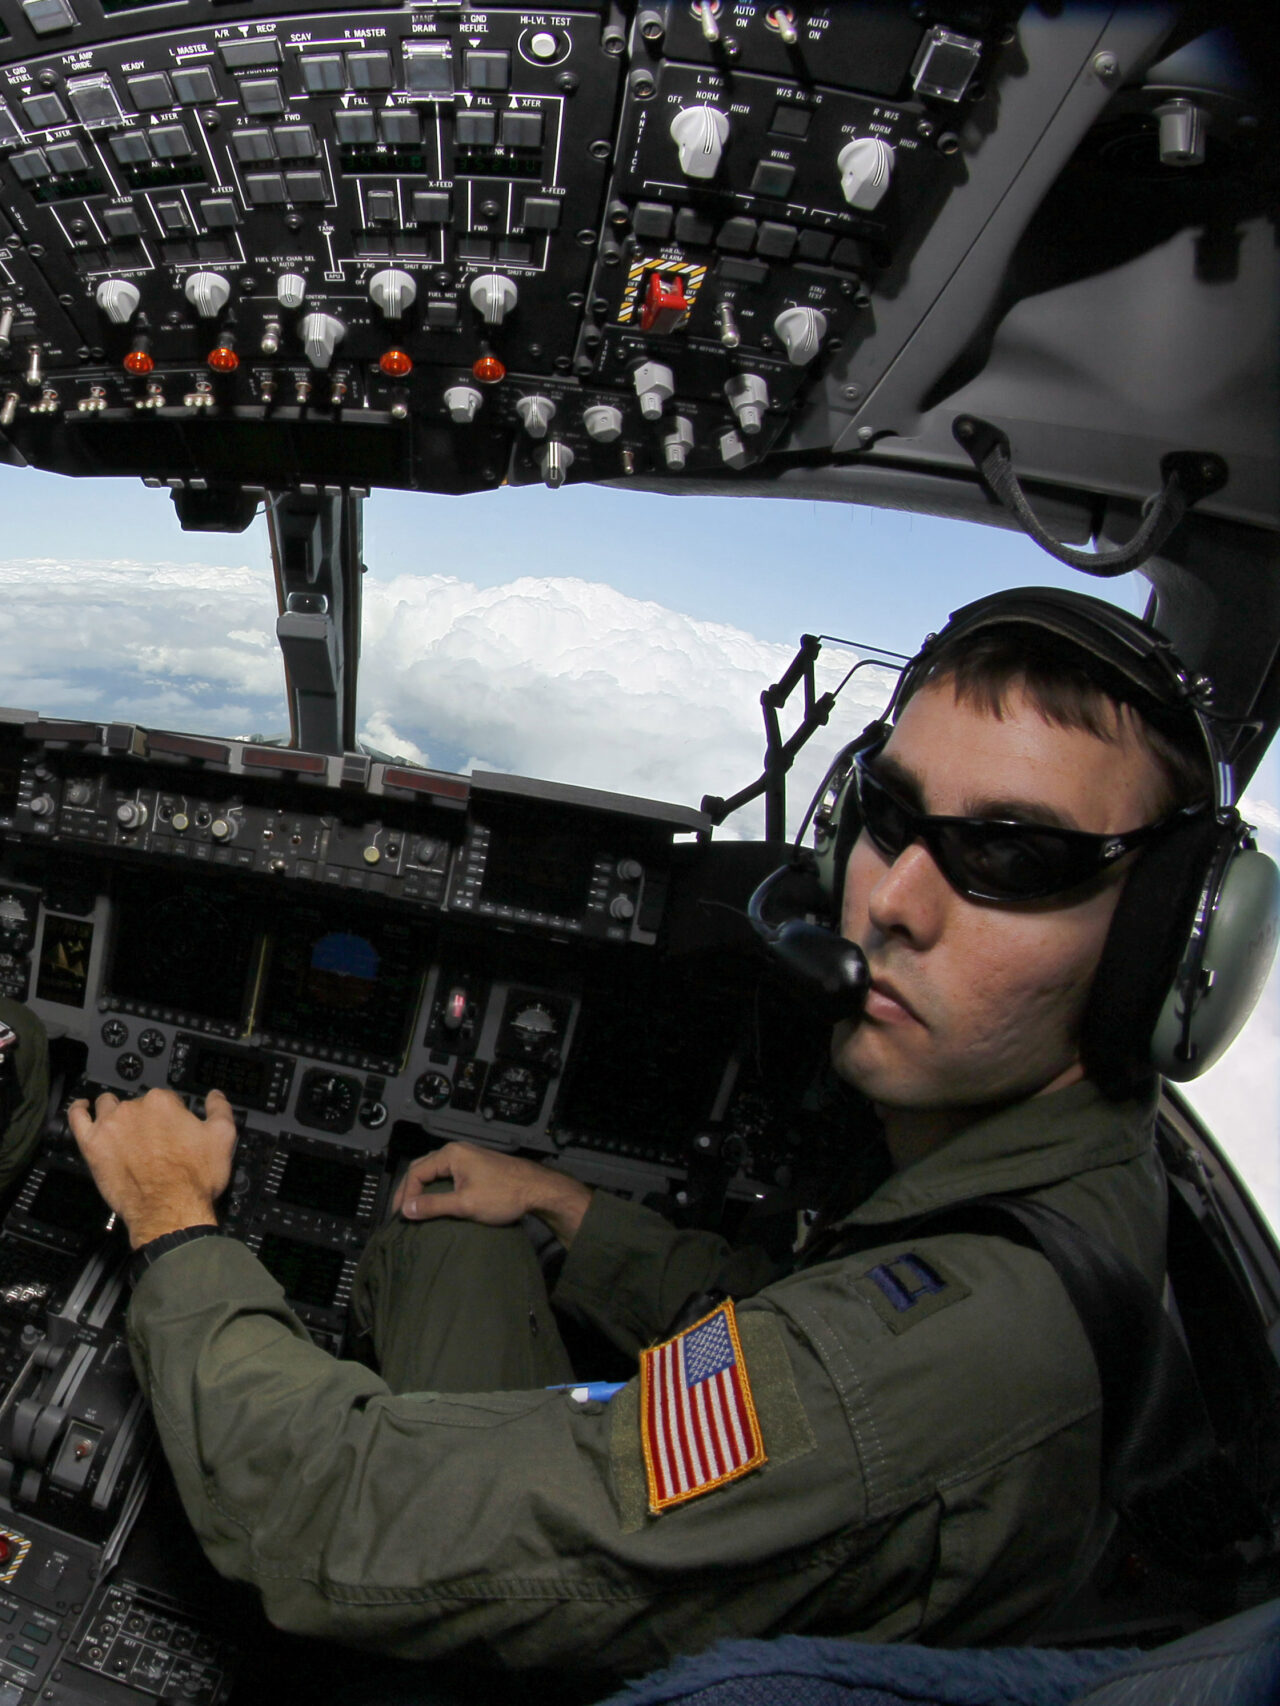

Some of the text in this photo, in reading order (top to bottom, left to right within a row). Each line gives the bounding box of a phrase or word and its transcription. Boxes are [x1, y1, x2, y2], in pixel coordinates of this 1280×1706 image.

[733, 5, 756, 16] AUTO
[470, 14, 487, 23] GND
[520, 16, 572, 26] HI-LVL TEST
[736, 18, 748, 28] ON
[807, 17, 830, 29] AUTO
[256, 23, 277, 33] RECP
[412, 24, 437, 32] DRAIN
[459, 24, 489, 32] REFUEL
[214, 29, 230, 38] A/R
[290, 33, 312, 42] SCAV
[344, 28, 387, 38] R MASTER
[809, 30, 821, 40] ON
[169, 44, 208, 56] L MASTER
[61, 52, 94, 64] A/R AMP
[12, 66, 27, 75] GND
[120, 61, 145, 71] READY
[7, 73, 33, 85] REFUEL
[697, 75, 724, 86] L W/S
[696, 91, 720, 101] NORM
[776, 87, 793, 98] W/S
[477, 97, 492, 105] FILL
[522, 99, 542, 108] XFER
[667, 95, 683, 103] OFF
[731, 104, 750, 114] HIGH
[160, 113, 179, 121] XFER
[873, 108, 900, 120] R W/S
[841, 125, 857, 134] OFF
[869, 123, 892, 134] NORM
[54, 129, 72, 138] XFER
[630, 111, 646, 173] ANTI ICE
[899, 139, 918, 148] HIGH
[771, 150, 791, 160] WING
[211, 186, 234, 194] X-FEED
[541, 187, 567, 195] X-FEED
[111, 196, 133, 204] X-FEED
[660, 253, 683, 262] ALARM
[808, 292, 823, 300] TEST
[740, 309, 755, 317] ARM
